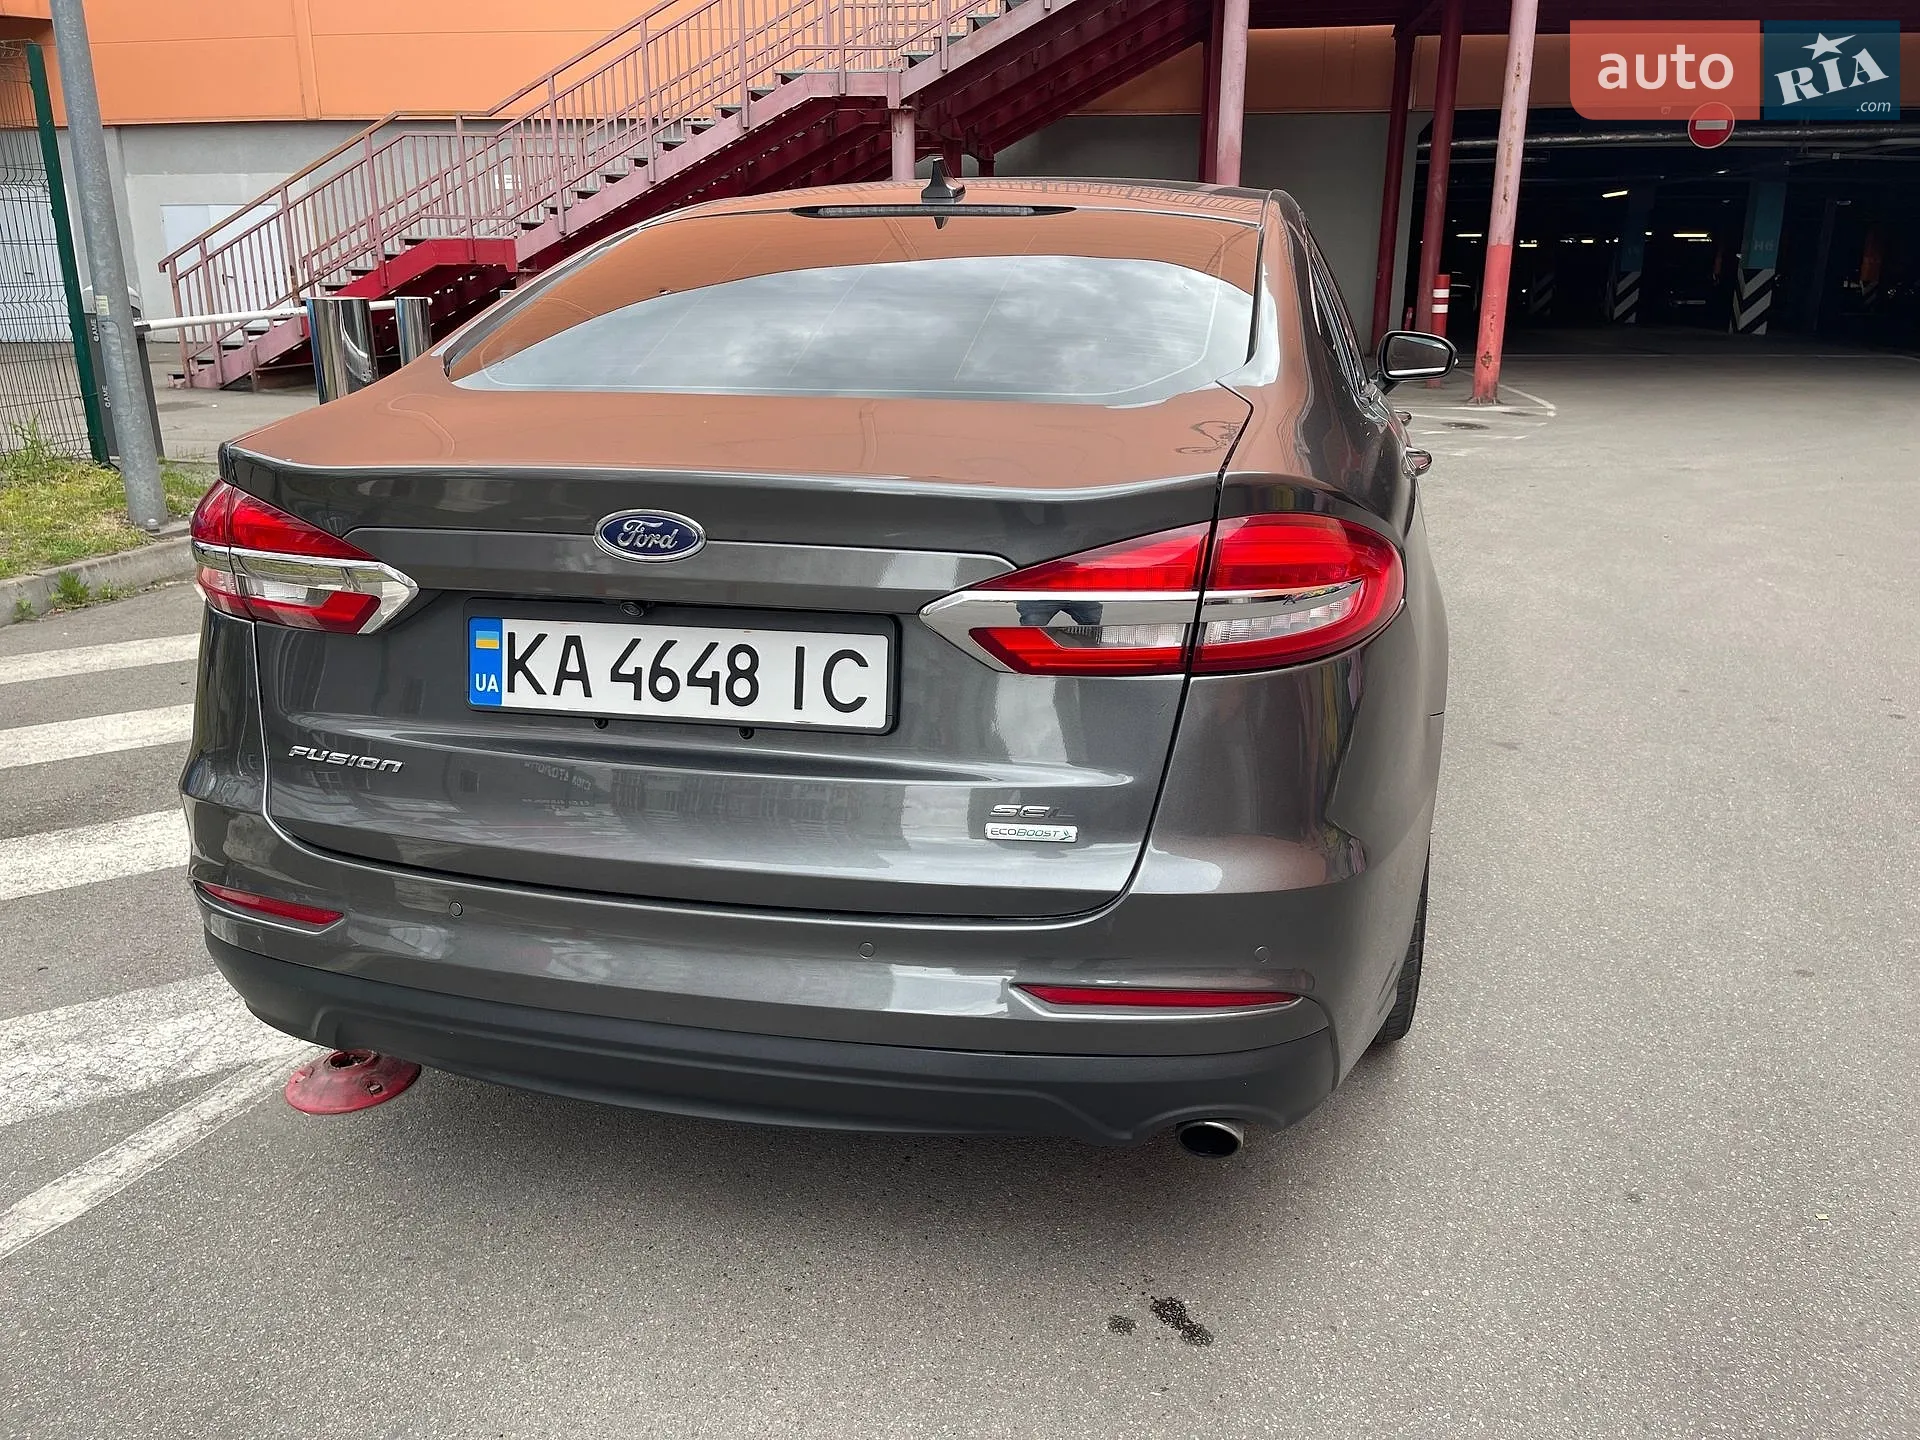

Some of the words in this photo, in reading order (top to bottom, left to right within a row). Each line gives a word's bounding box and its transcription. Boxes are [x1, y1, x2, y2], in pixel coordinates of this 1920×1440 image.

[617, 519, 679, 549] Ford
[475, 673, 499, 693] UA
[507, 632, 593, 698] KA
[610, 638, 760, 707] 4648
[793, 646, 869, 713] IC
[288, 745, 403, 773] FUSION
[990, 827, 1060, 837] ECOBOOST
